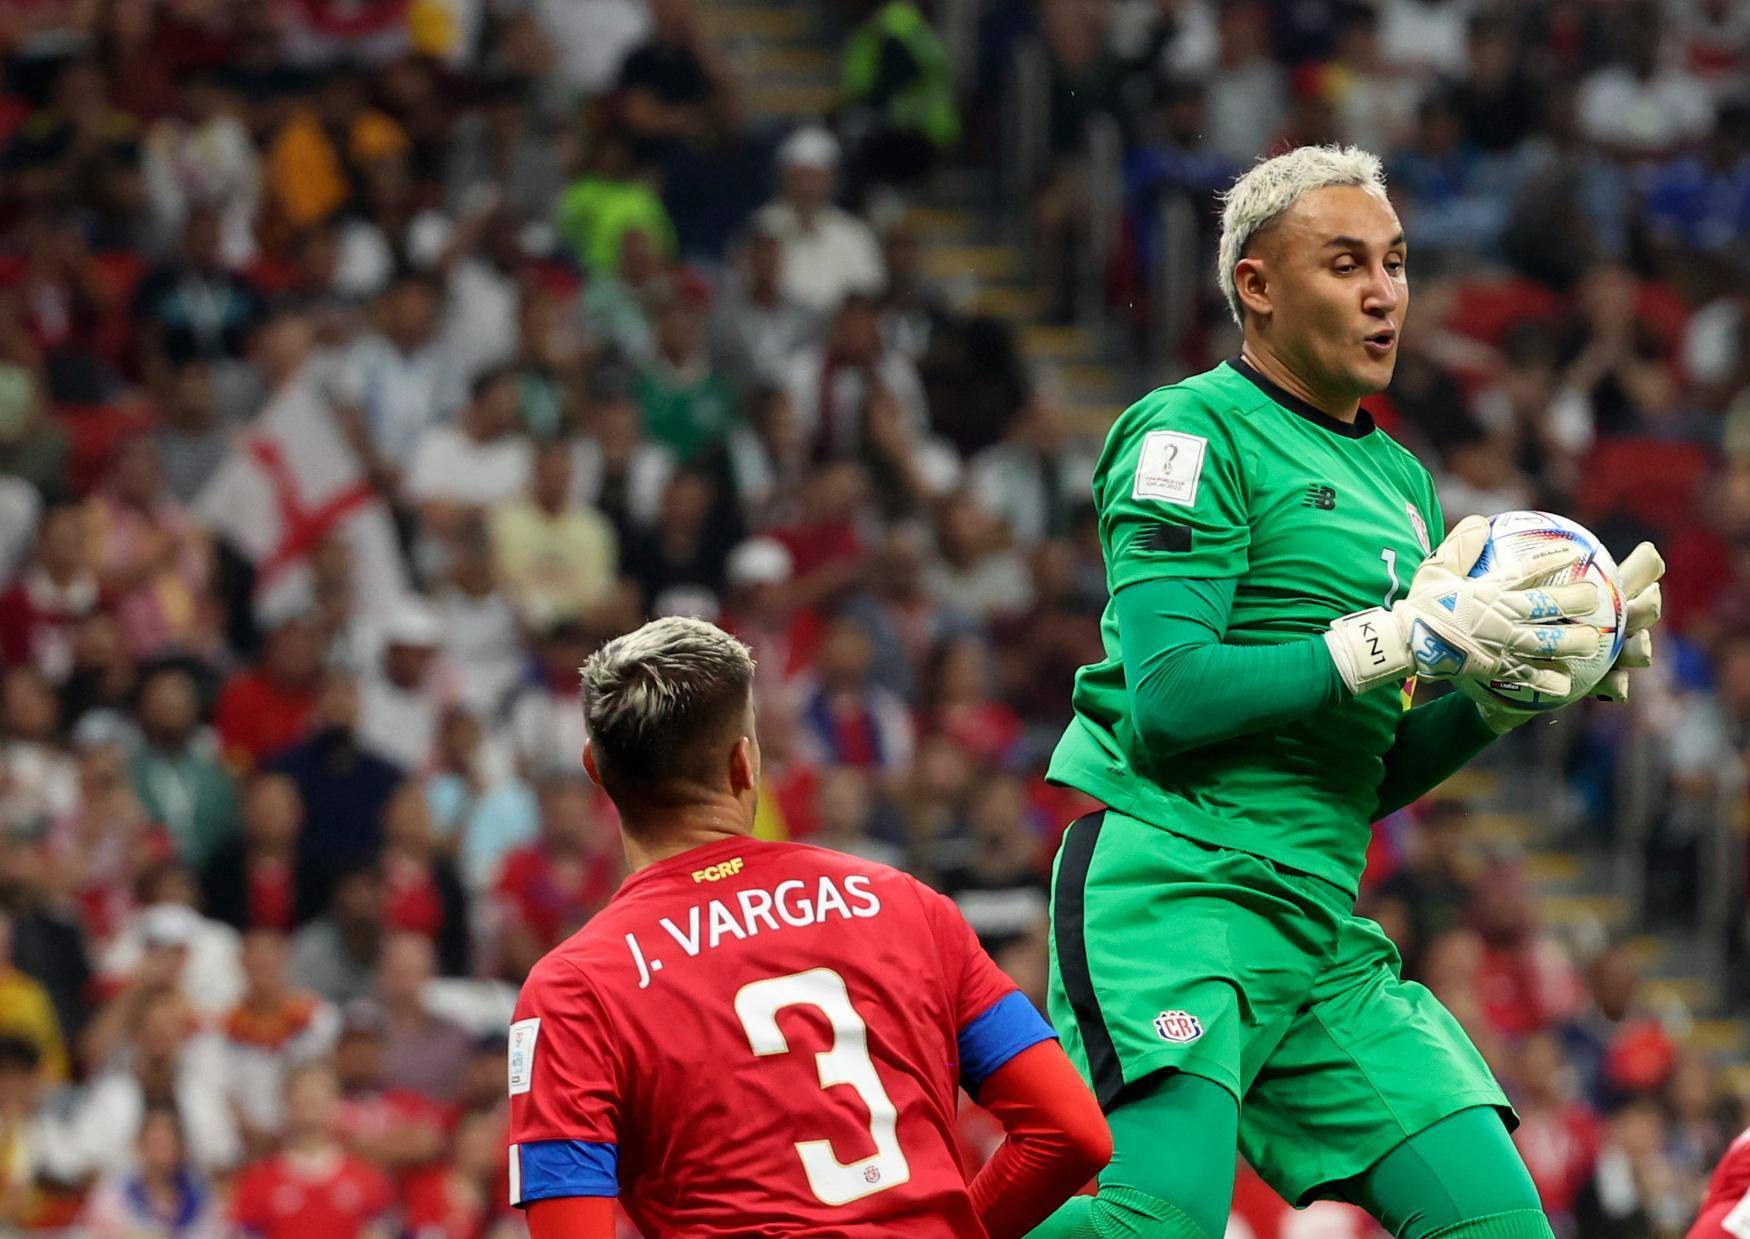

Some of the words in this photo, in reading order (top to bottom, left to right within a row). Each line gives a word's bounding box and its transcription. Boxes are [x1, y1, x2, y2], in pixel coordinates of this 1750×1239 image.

[1359, 622, 1386, 665] KN1
[691, 856, 744, 883] FCRF
[625, 932, 663, 988] J.
[659, 874, 881, 956] VARGAS
[1164, 1018, 1192, 1037] CR
[733, 966, 911, 1206] 3
